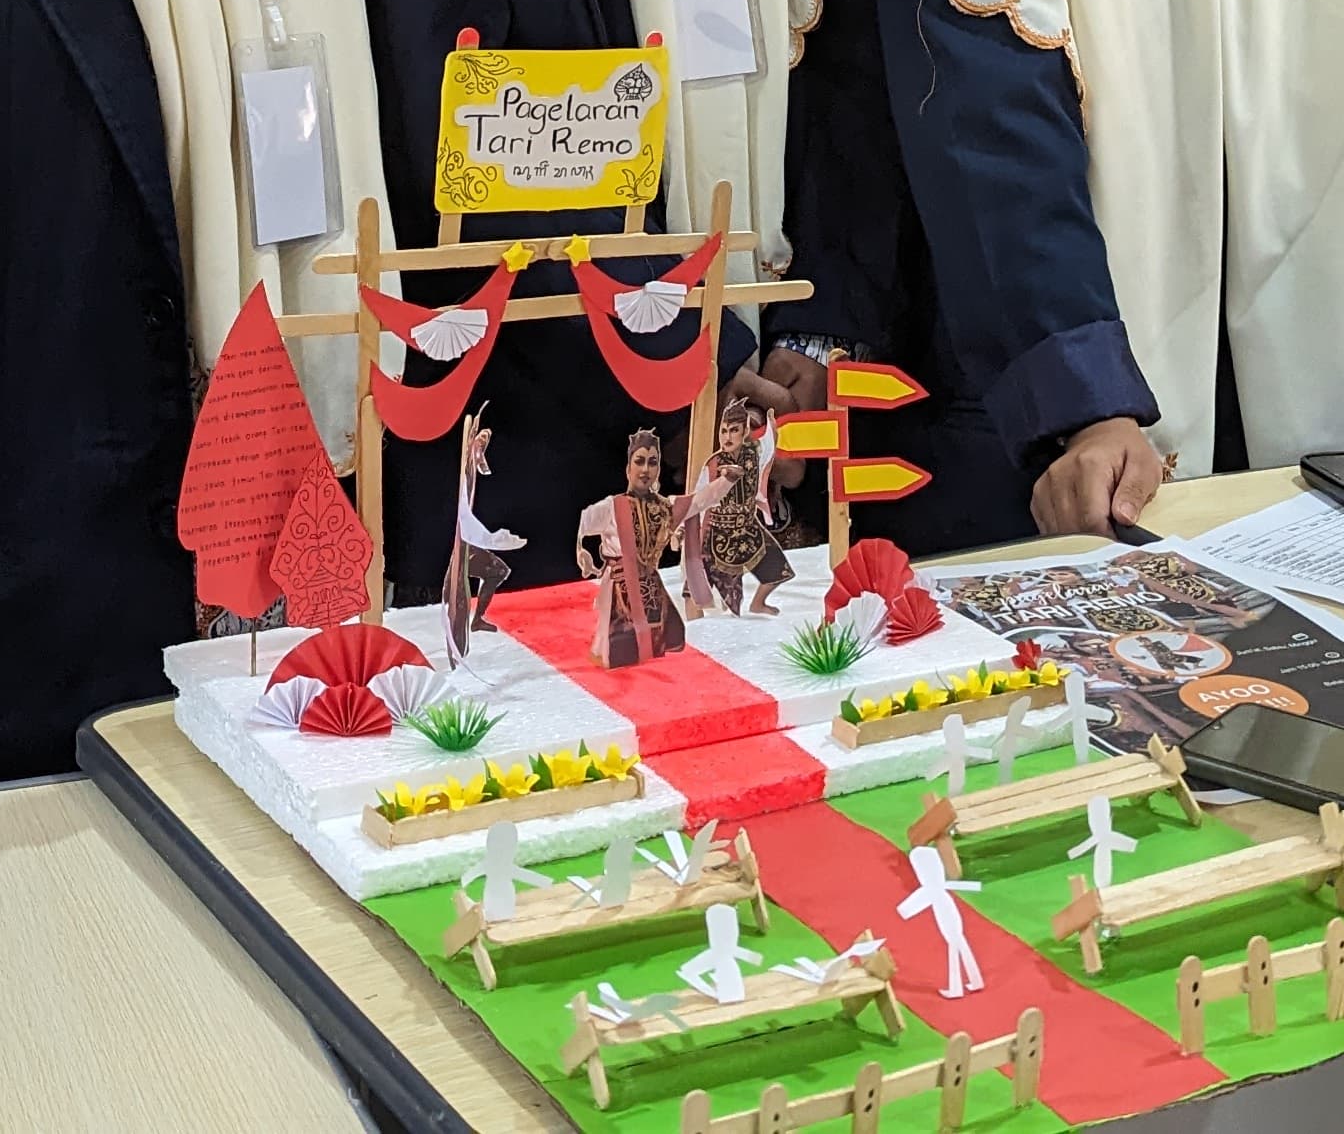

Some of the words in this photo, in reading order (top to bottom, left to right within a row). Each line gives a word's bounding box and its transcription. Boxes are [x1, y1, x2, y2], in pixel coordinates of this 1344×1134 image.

[503, 86, 640, 135] Pagelaran
[464, 114, 533, 155] Tari
[552, 126, 633, 155] Remo
[993, 606, 1073, 625] TARI
[1078, 590, 1167, 616] REMO
[1198, 684, 1271, 703] AYOO
